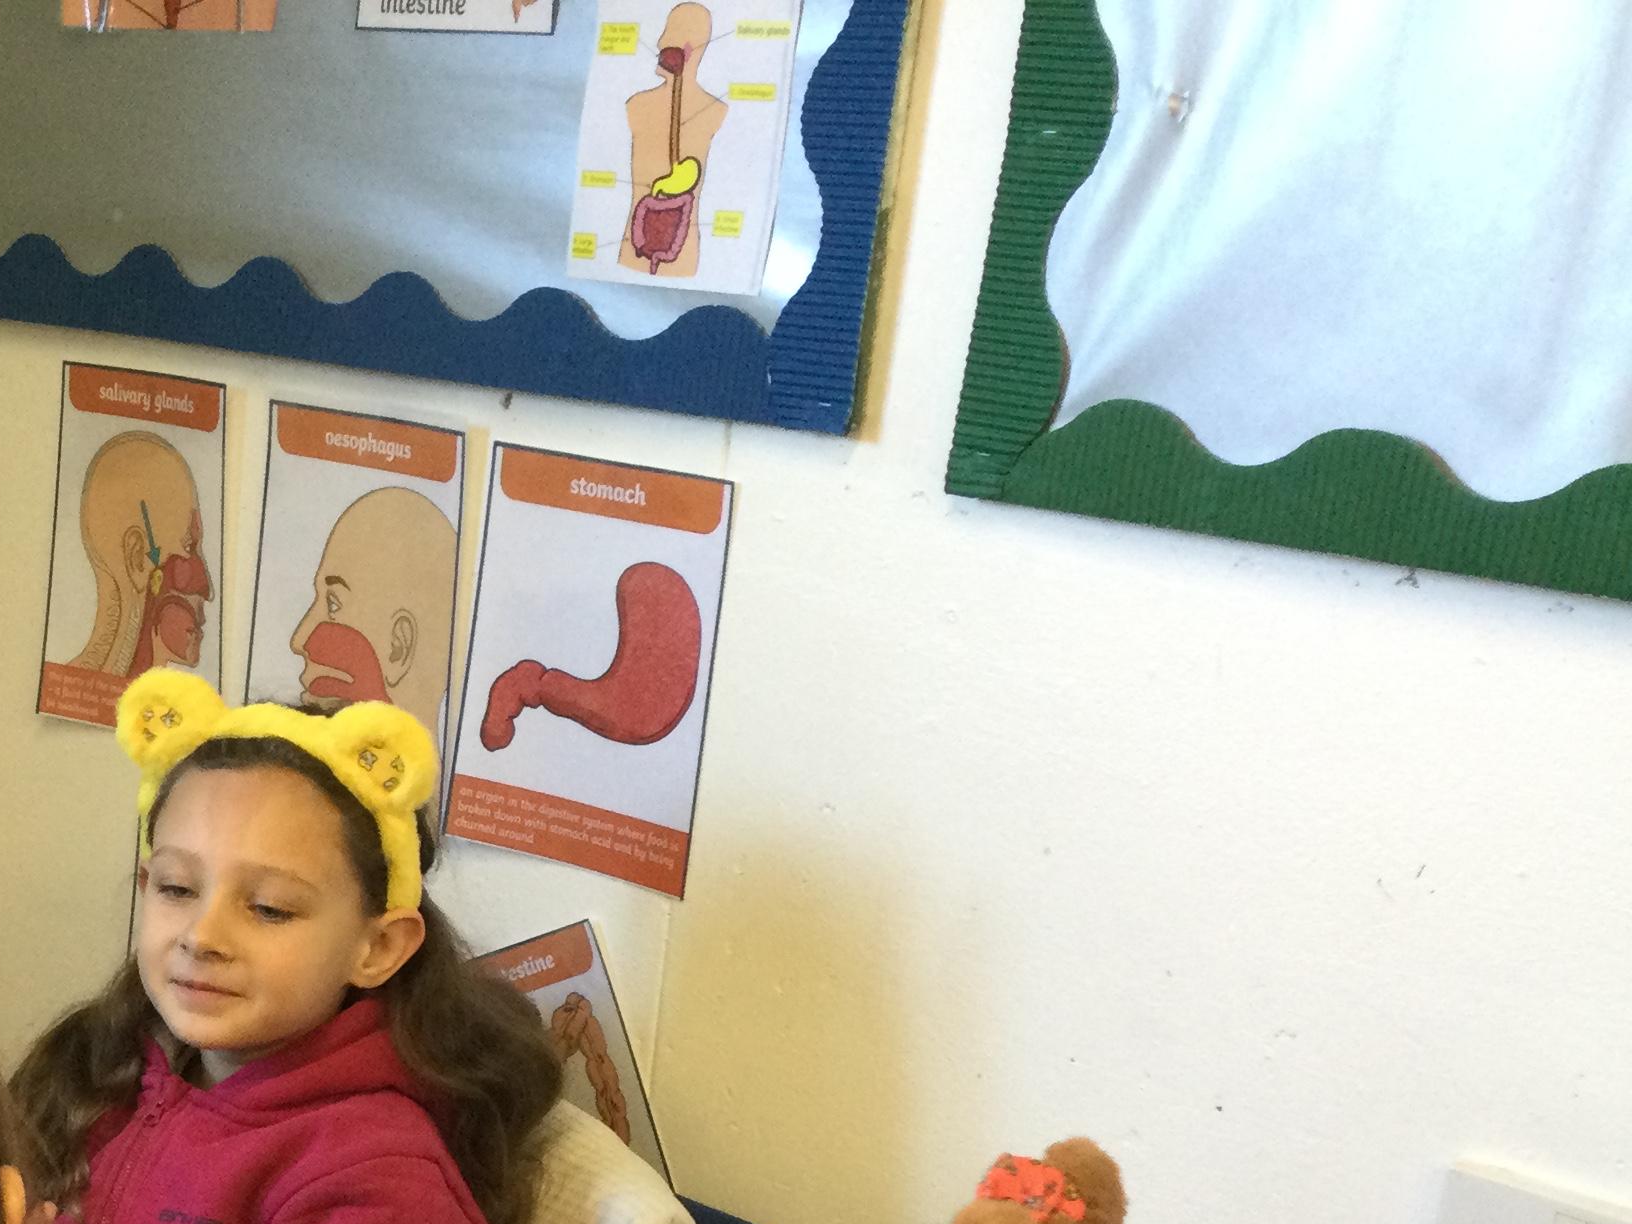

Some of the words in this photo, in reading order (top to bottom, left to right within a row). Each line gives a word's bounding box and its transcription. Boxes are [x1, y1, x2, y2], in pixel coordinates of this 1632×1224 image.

[99, 384, 151, 412] salivary
[154, 392, 195, 415] glands
[325, 430, 412, 461] oesophagus
[570, 477, 647, 507] stomach
